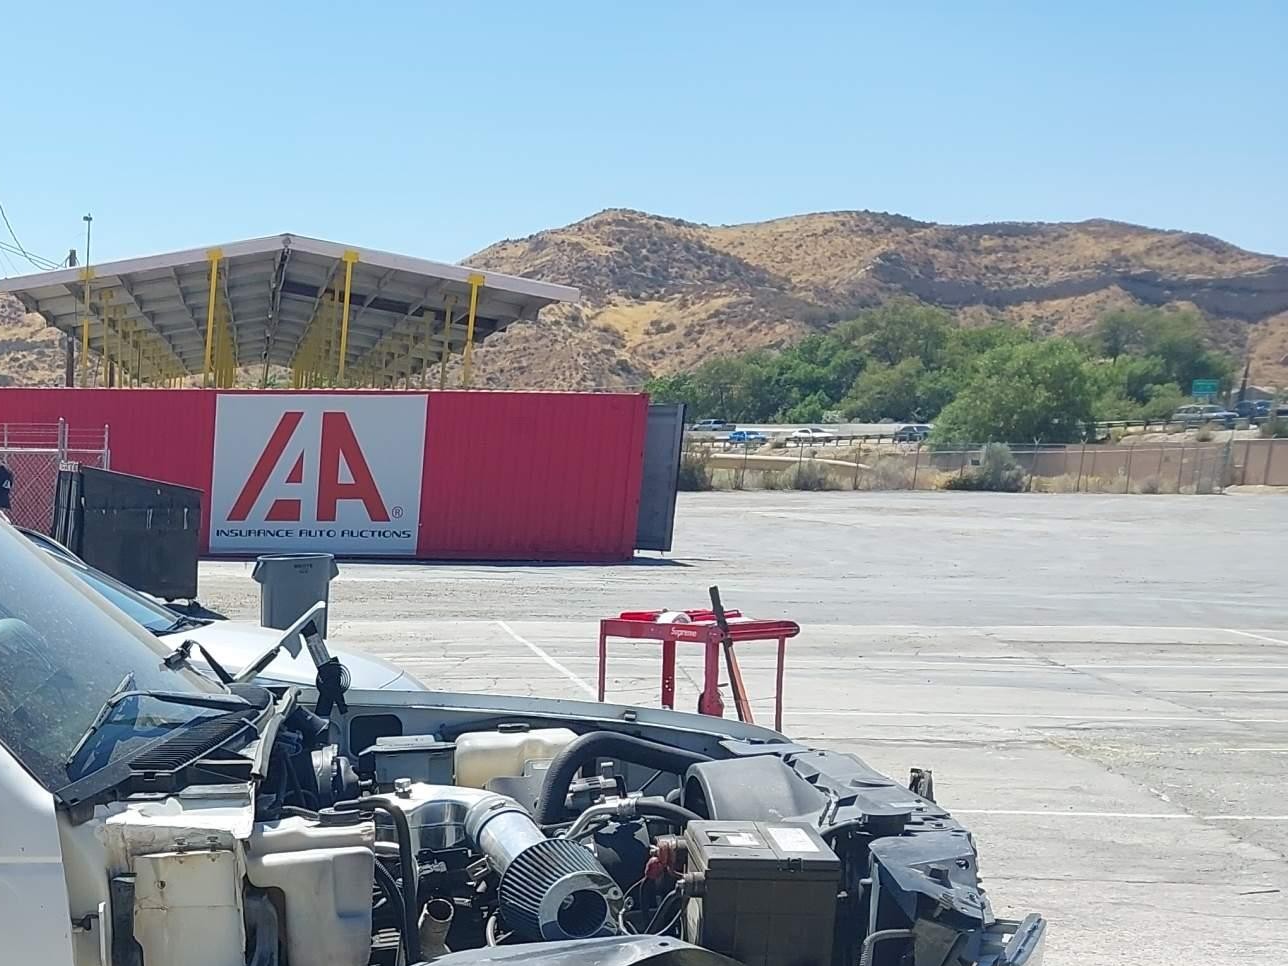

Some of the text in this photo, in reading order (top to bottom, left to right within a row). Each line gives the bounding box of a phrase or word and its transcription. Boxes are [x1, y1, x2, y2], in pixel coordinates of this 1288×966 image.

[216, 528, 412, 539] INSURANCE AUTO AUCTIONS
